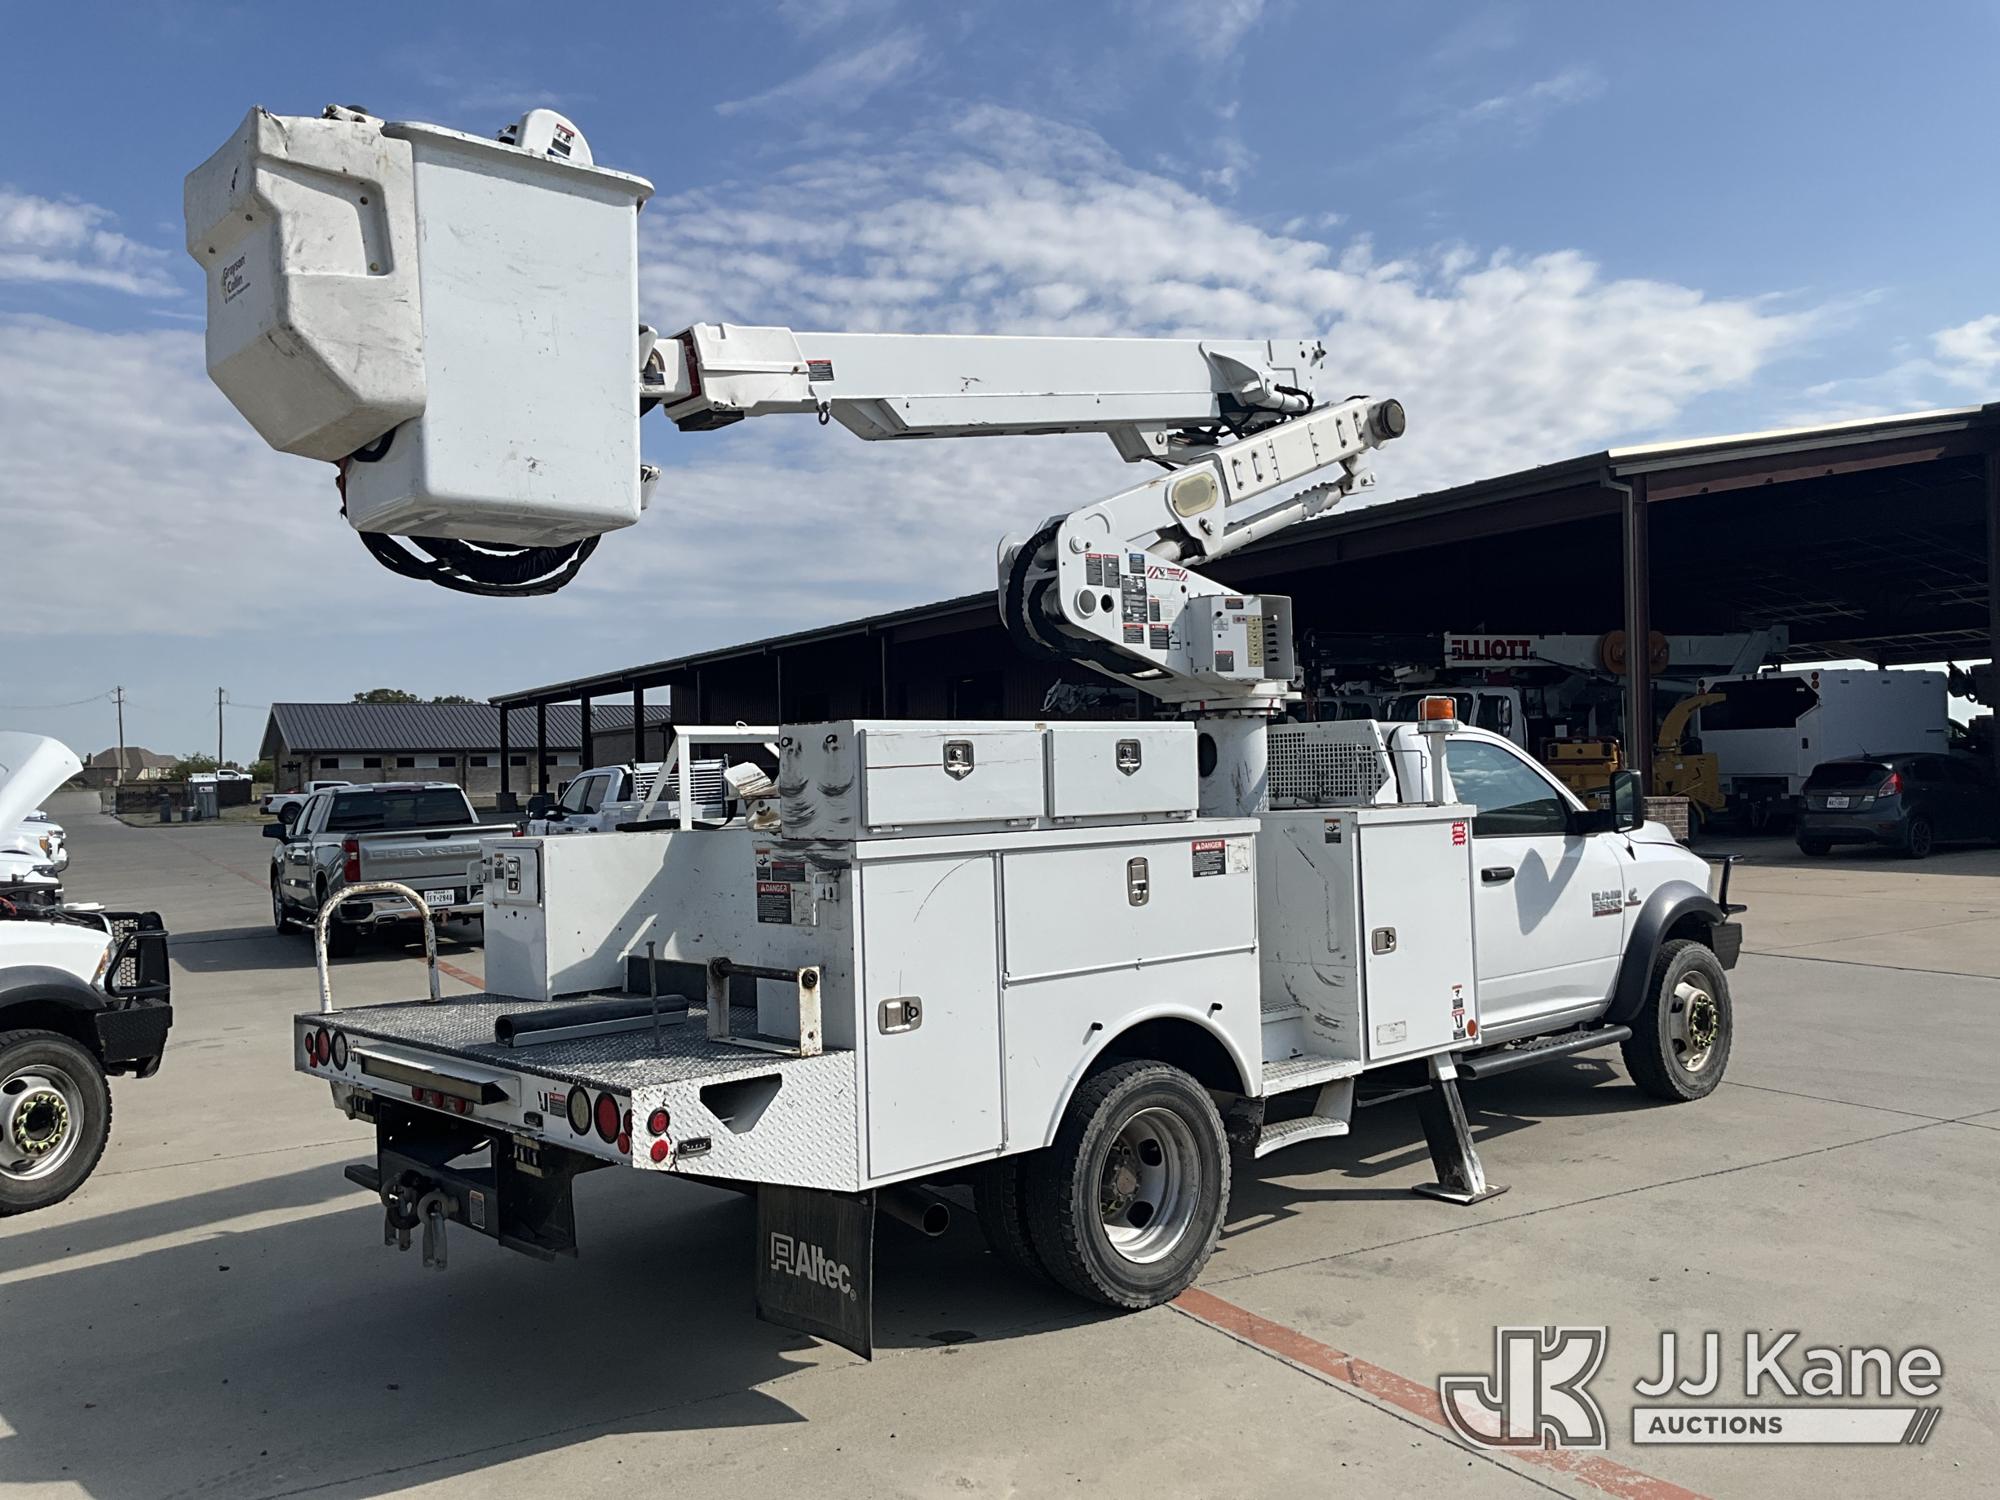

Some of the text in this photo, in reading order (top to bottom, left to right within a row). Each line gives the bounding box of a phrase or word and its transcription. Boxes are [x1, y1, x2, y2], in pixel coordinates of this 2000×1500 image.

[1451, 639, 1531, 660] ELLIOTT
[371, 845, 480, 859] CHEVROL
[1200, 841, 1222, 850] DANGER
[766, 884, 788, 892] DANGER
[795, 1241, 851, 1294] Altec
